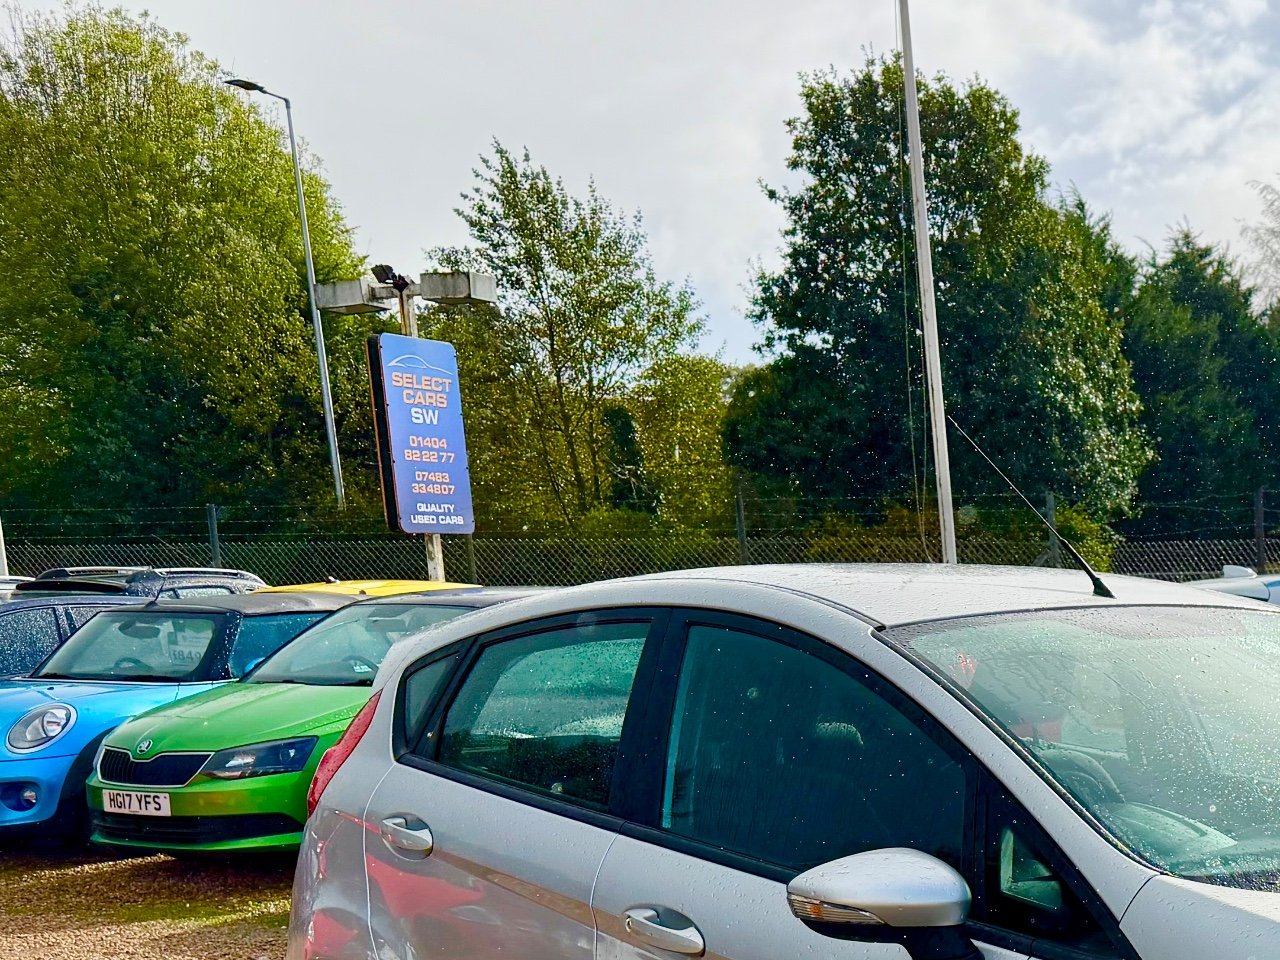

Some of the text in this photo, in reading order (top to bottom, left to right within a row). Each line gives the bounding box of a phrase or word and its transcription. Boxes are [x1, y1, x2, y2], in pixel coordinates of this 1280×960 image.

[391, 371, 452, 393] SELECT
[402, 389, 448, 409] CARS
[410, 407, 439, 425] SW
[409, 435, 448, 449] 01404
[404, 449, 455, 464] 82 22 77
[415, 470, 450, 483] 07483
[411, 483, 455, 495] 334807
[416, 502, 455, 513] QUALITY
[410, 514, 464, 525] USED CARS
[108, 791, 162, 811] HG17 YFS
